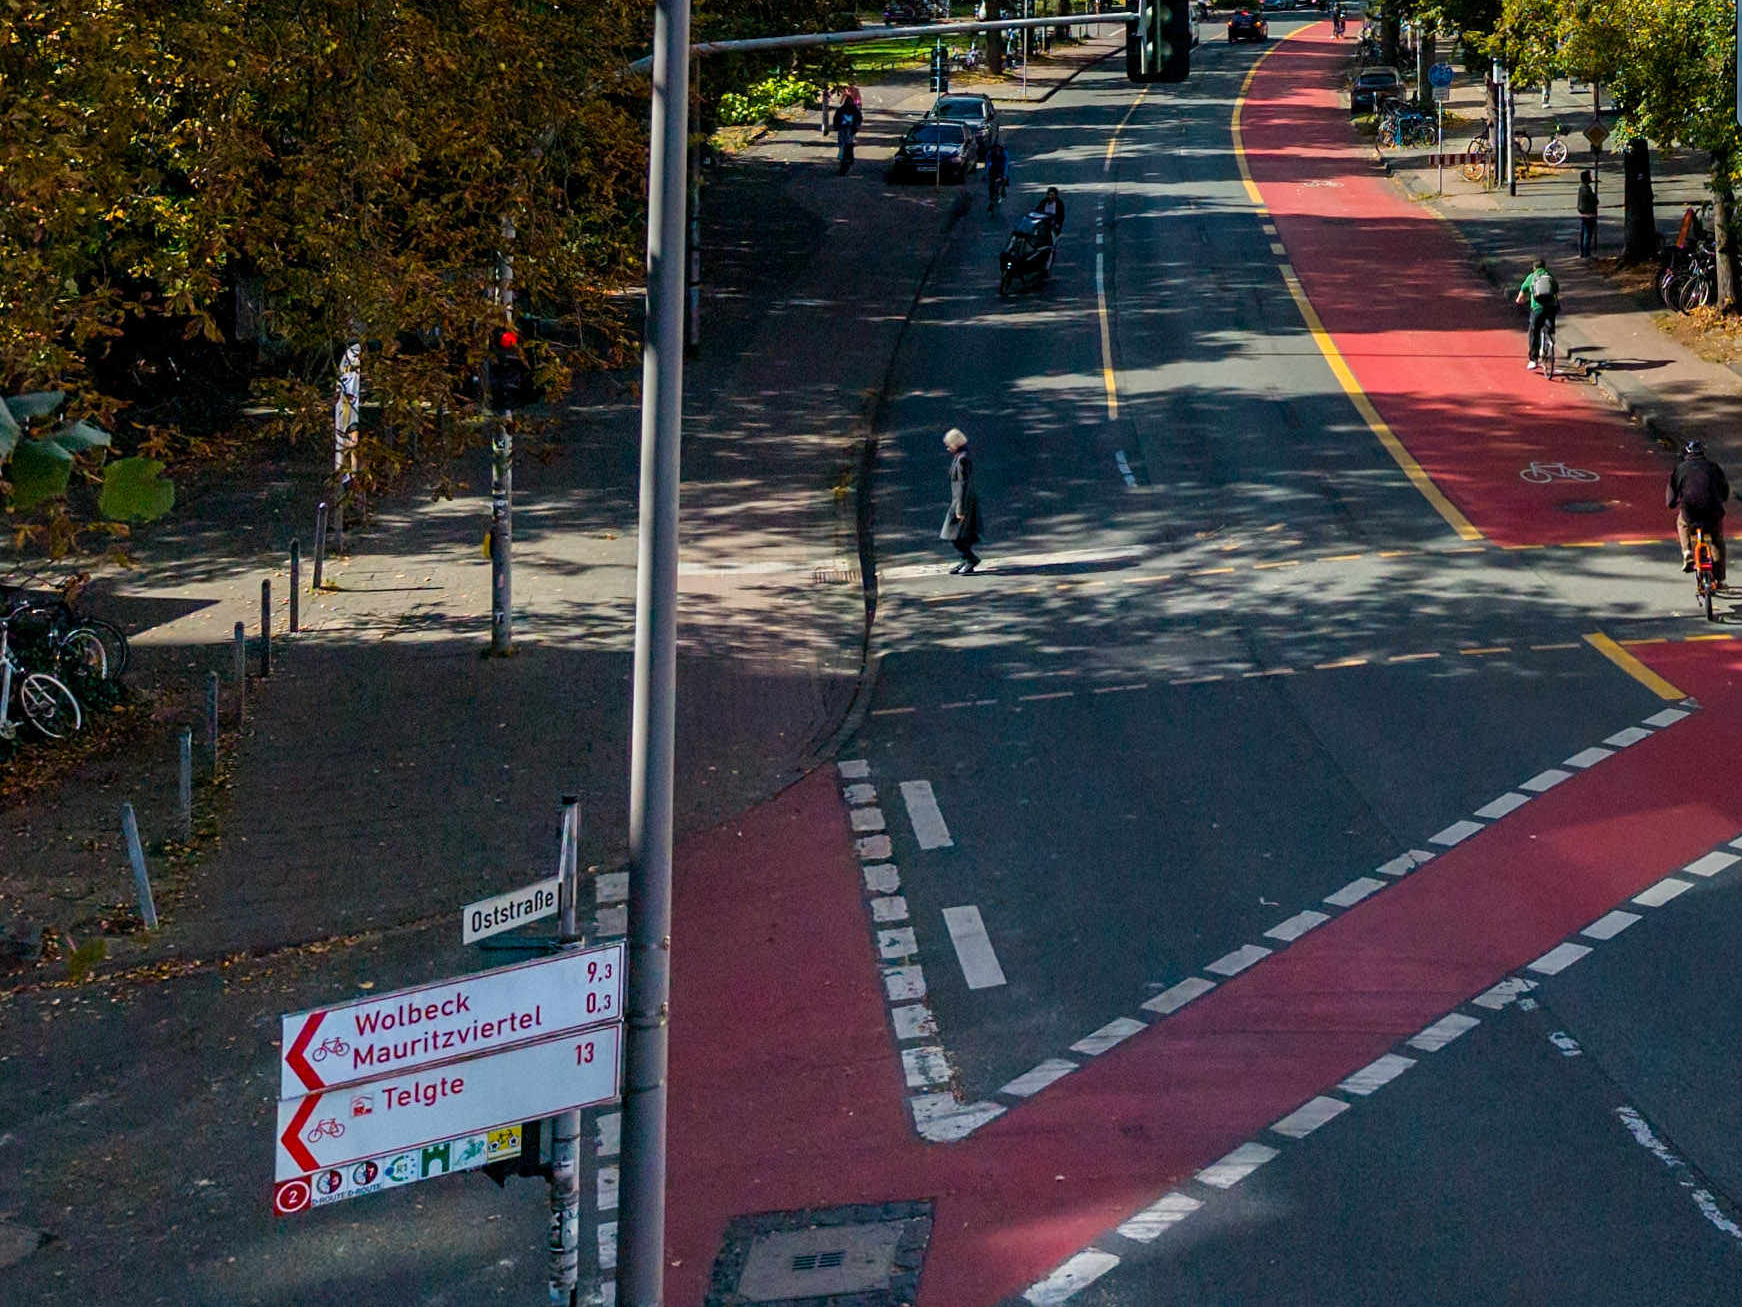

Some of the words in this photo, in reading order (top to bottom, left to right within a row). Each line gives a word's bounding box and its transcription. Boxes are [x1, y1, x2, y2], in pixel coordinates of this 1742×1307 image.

[472, 890, 554, 933] Oststraße
[355, 992, 470, 1036] Wolbeck
[353, 1005, 542, 1069] Mauritzviertel
[382, 1077, 464, 1110] Telgte
[575, 1041, 595, 1066] 13
[368, 1167, 375, 1177] 7
[289, 1190, 298, 1205] 2
